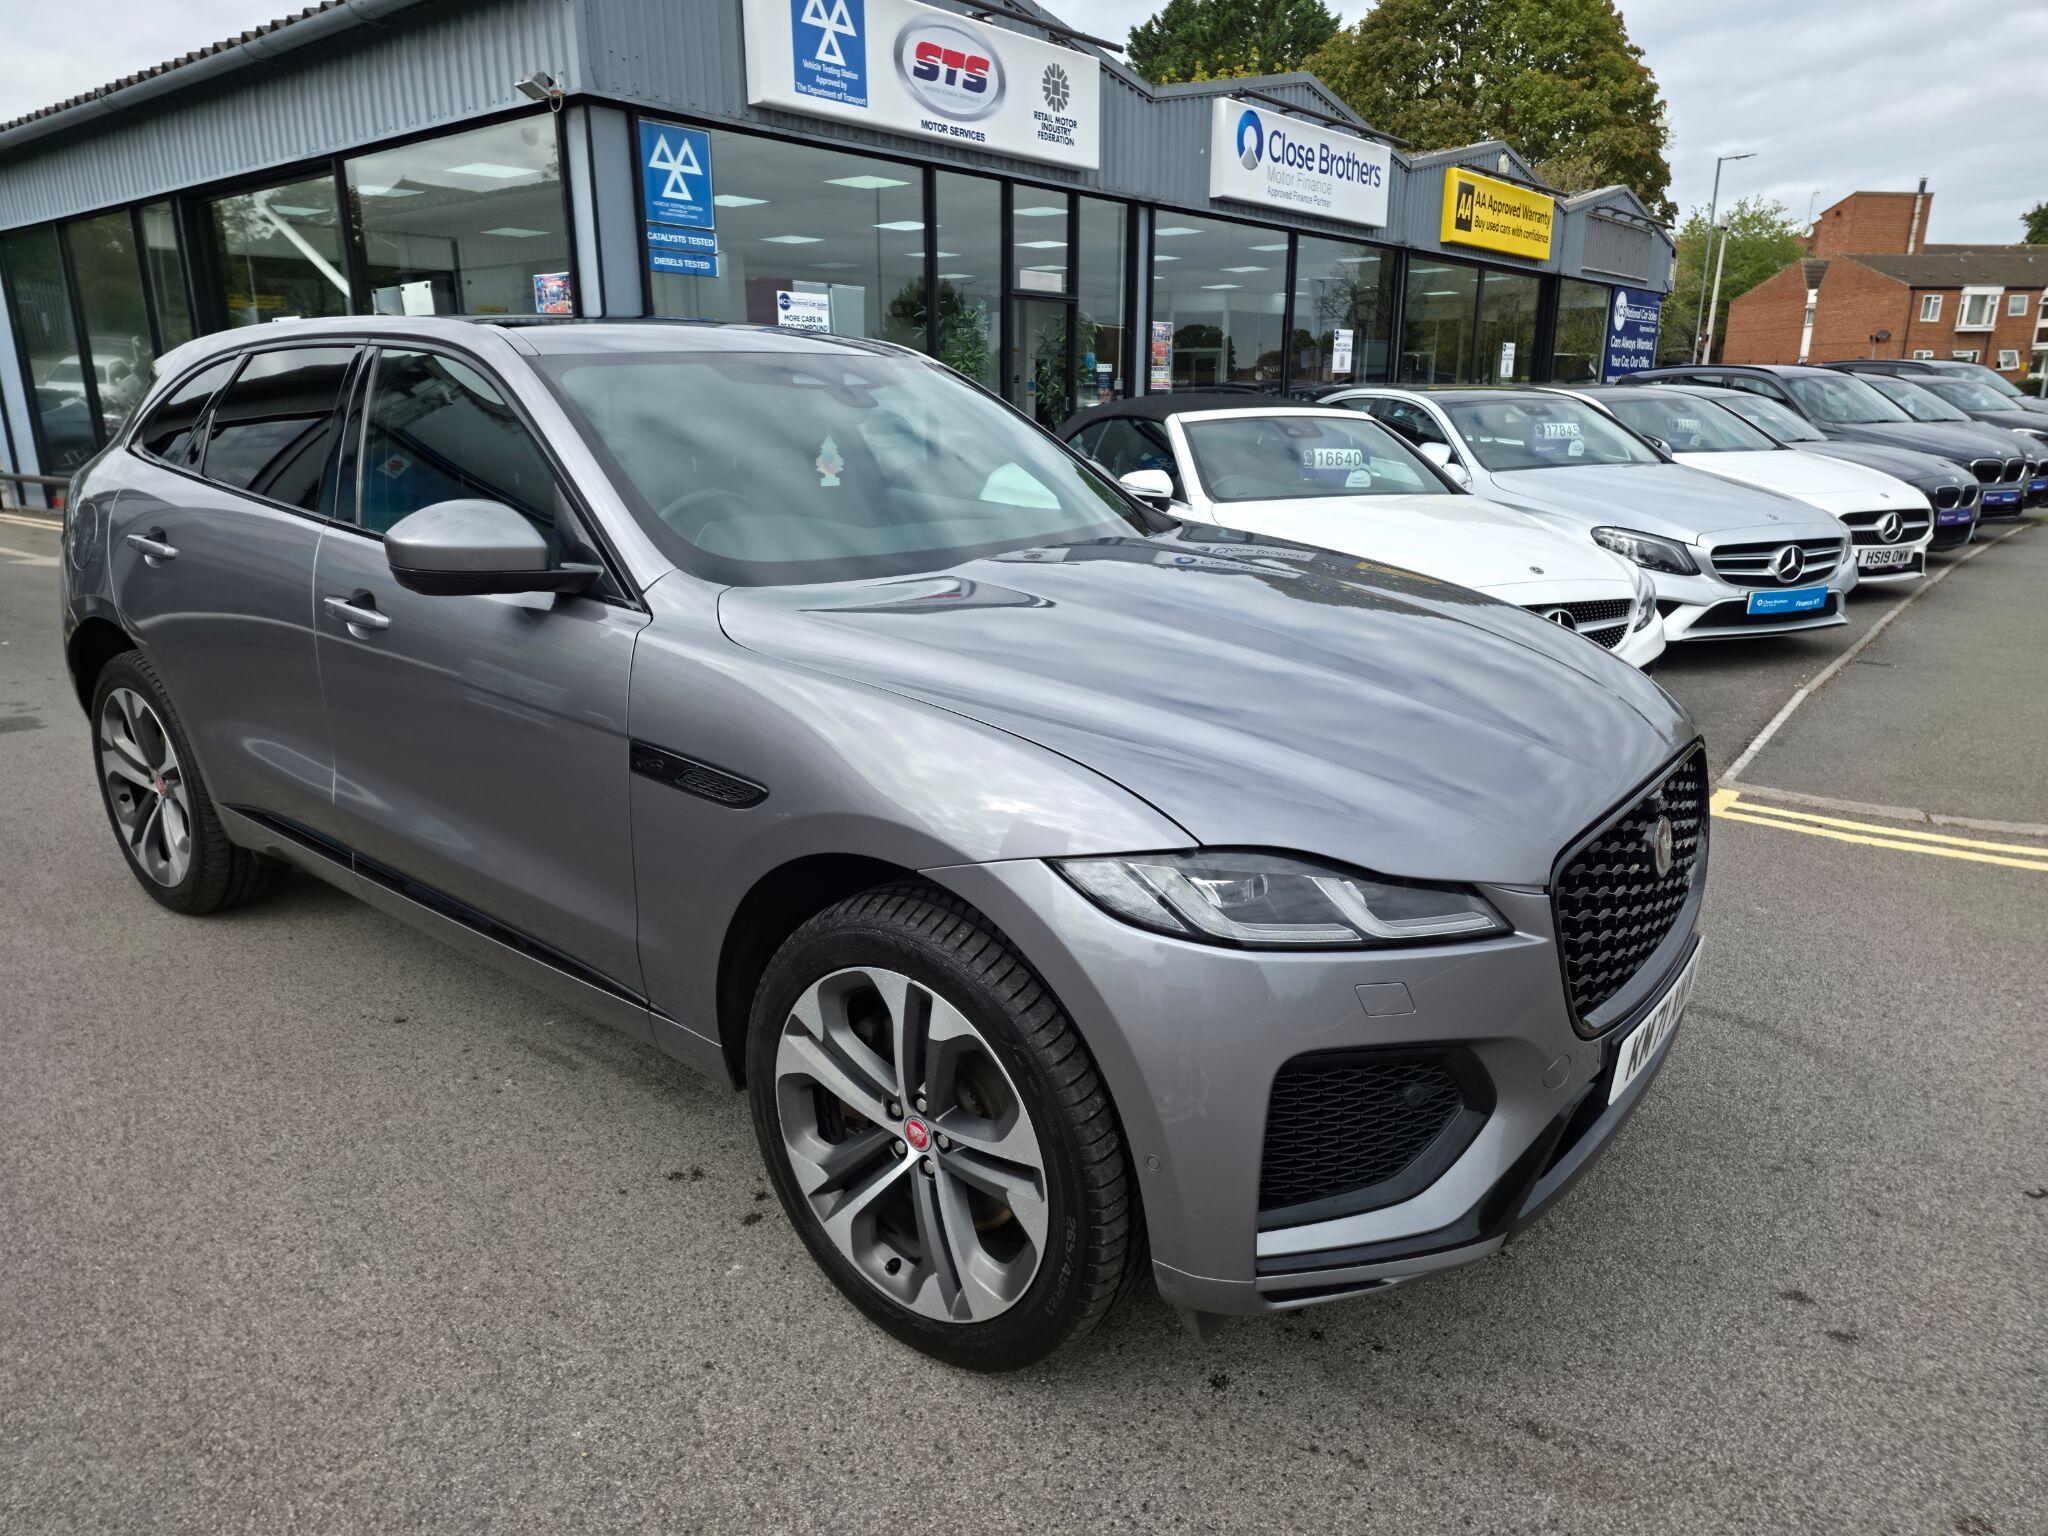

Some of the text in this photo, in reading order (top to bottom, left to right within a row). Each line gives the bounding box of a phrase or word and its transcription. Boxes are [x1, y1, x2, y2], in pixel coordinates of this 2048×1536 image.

[802, 59, 858, 80] Vehicle Testing Station
[913, 41, 990, 94] STS
[816, 75, 848, 91] Approved by
[796, 82, 807, 91] The
[807, 85, 836, 96] Department
[842, 93, 866, 105] Transport
[1033, 110, 1077, 129] RETAIL MOTOR
[1041, 122, 1072, 136] INDUSTRY
[921, 119, 986, 142] MOTOR SERVICES
[1037, 130, 1075, 146] FEDERATION
[1268, 129, 1381, 188] Close Brothers
[1267, 165, 1333, 195] Motor Finance
[1267, 186, 1332, 208] Approved Finance Partner
[1457, 193, 1472, 221] AA
[1475, 191, 1551, 229] AA Approved Warranty
[647, 231, 714, 247] CATALYSTS TESTED
[1474, 215, 1549, 244] Buy used cars with confidence
[654, 256, 711, 270] DIESELS TESTED
[784, 314, 800, 322] MORE
[800, 315, 816, 323] CARS
[1641, 309, 1649, 320] Car
[1611, 335, 1621, 348] Cars
[1621, 337, 1636, 351] Always
[1611, 355, 1621, 367] Your
[1630, 356, 1639, 368] Our
[1866, 551, 1891, 564] HS19
